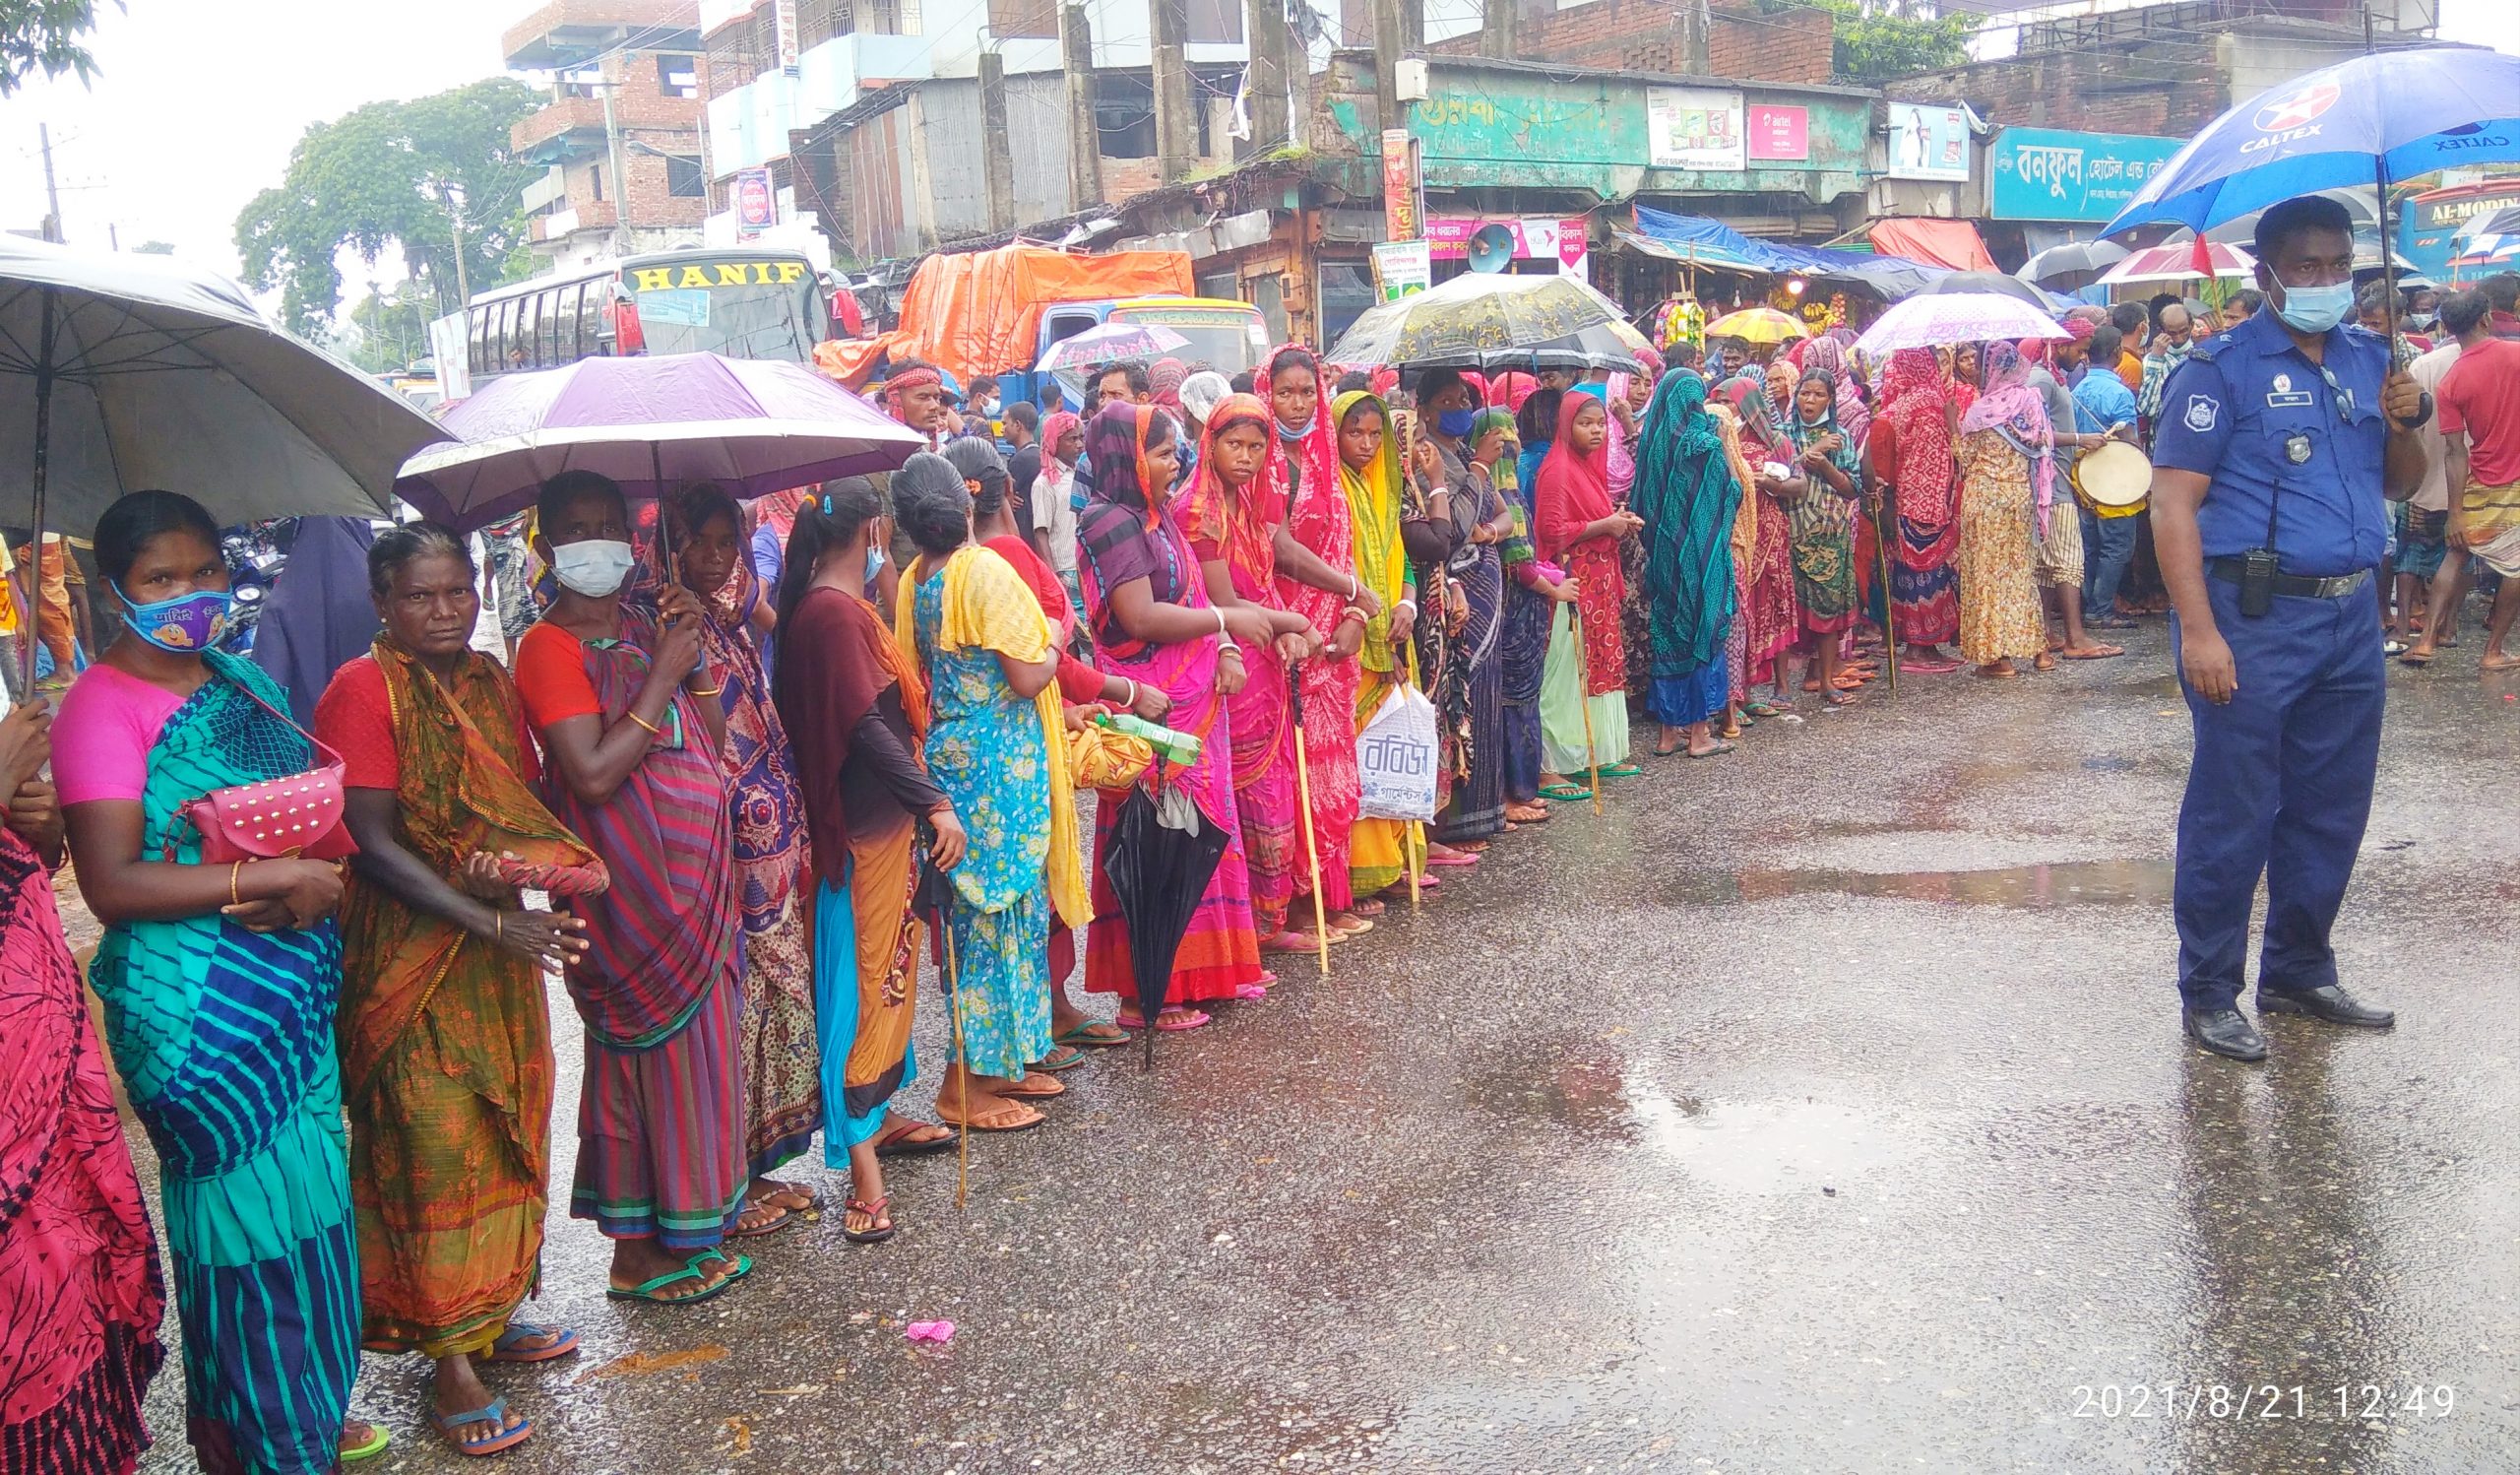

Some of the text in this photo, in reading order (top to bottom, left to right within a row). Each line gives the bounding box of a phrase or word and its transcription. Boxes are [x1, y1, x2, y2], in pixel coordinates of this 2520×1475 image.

[1772, 115, 1792, 127] airtel
[2239, 124, 2323, 154] CALTEX
[2017, 145, 2084, 200] বনফুল
[2089, 154, 2123, 181] হোটেল
[1559, 226, 1583, 240] বিকাশ
[1430, 238, 1451, 251] বিকাশ
[632, 262, 806, 292] HANIF
